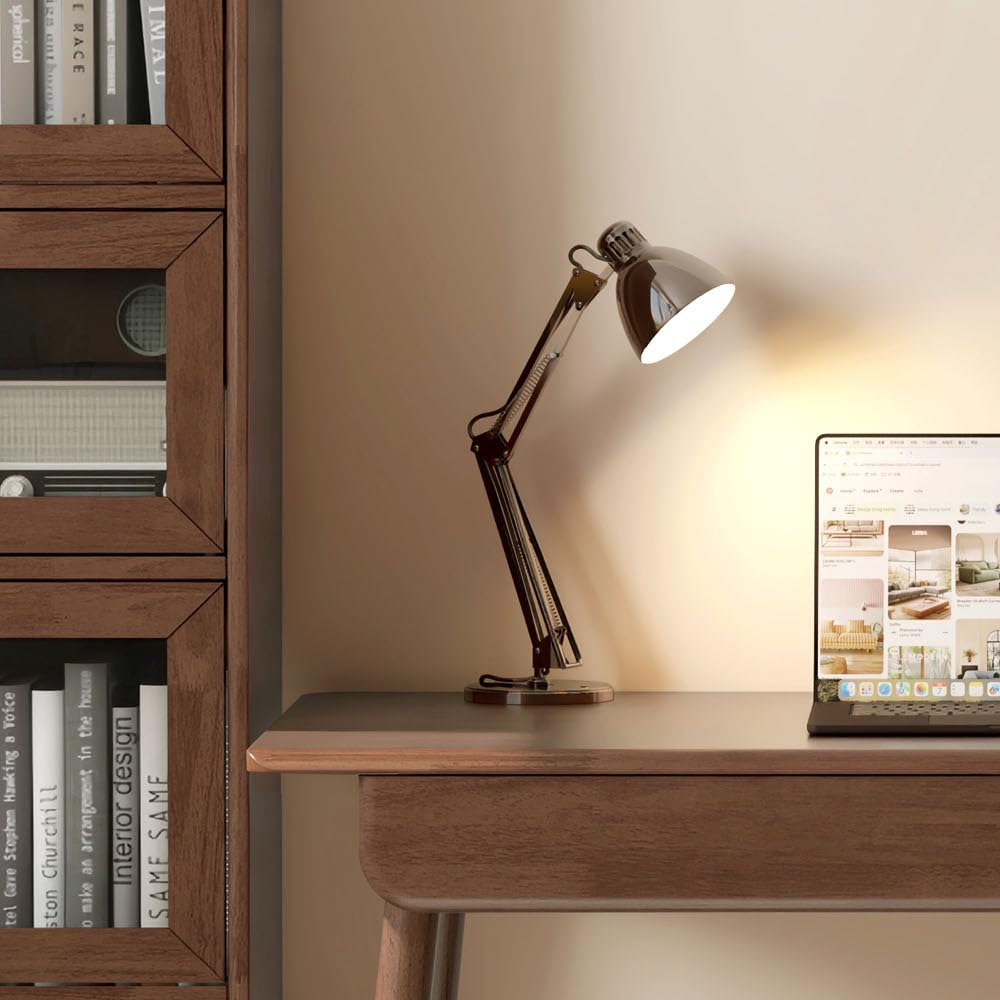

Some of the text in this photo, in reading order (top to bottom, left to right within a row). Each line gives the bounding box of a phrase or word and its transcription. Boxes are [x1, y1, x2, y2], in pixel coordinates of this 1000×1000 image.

[73, 23, 85, 73] RACE
[2, 692, 16, 729] Voice
[77, 716, 93, 737] the
[77, 746, 93, 760] in
[2, 750, 19, 802] Hawking
[113, 716, 138, 885] Interior design
[40, 784, 59, 879] Churchill
[82, 859, 93, 875] an
[79, 883, 94, 913] make
